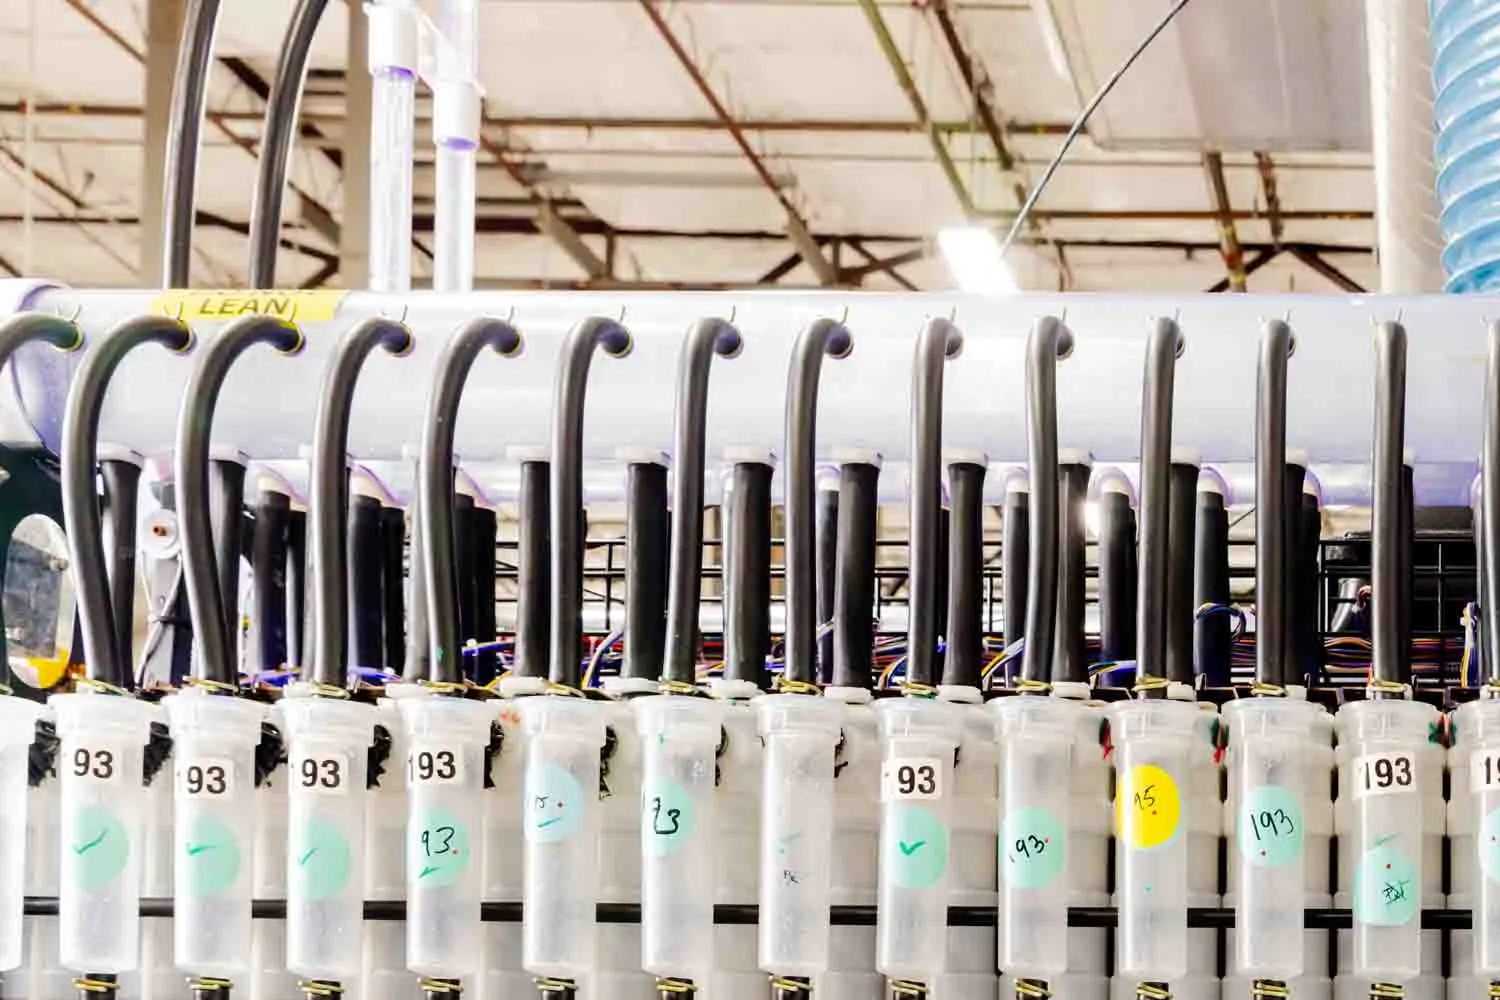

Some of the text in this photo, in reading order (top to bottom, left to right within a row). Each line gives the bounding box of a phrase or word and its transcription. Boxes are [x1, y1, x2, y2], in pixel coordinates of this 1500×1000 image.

[199, 298, 291, 315] LEAN
[178, 765, 227, 795] 93
[292, 758, 341, 788] 93
[885, 765, 937, 795] 93
[1363, 756, 1413, 791] 193
[1249, 807, 1295, 841] 193
